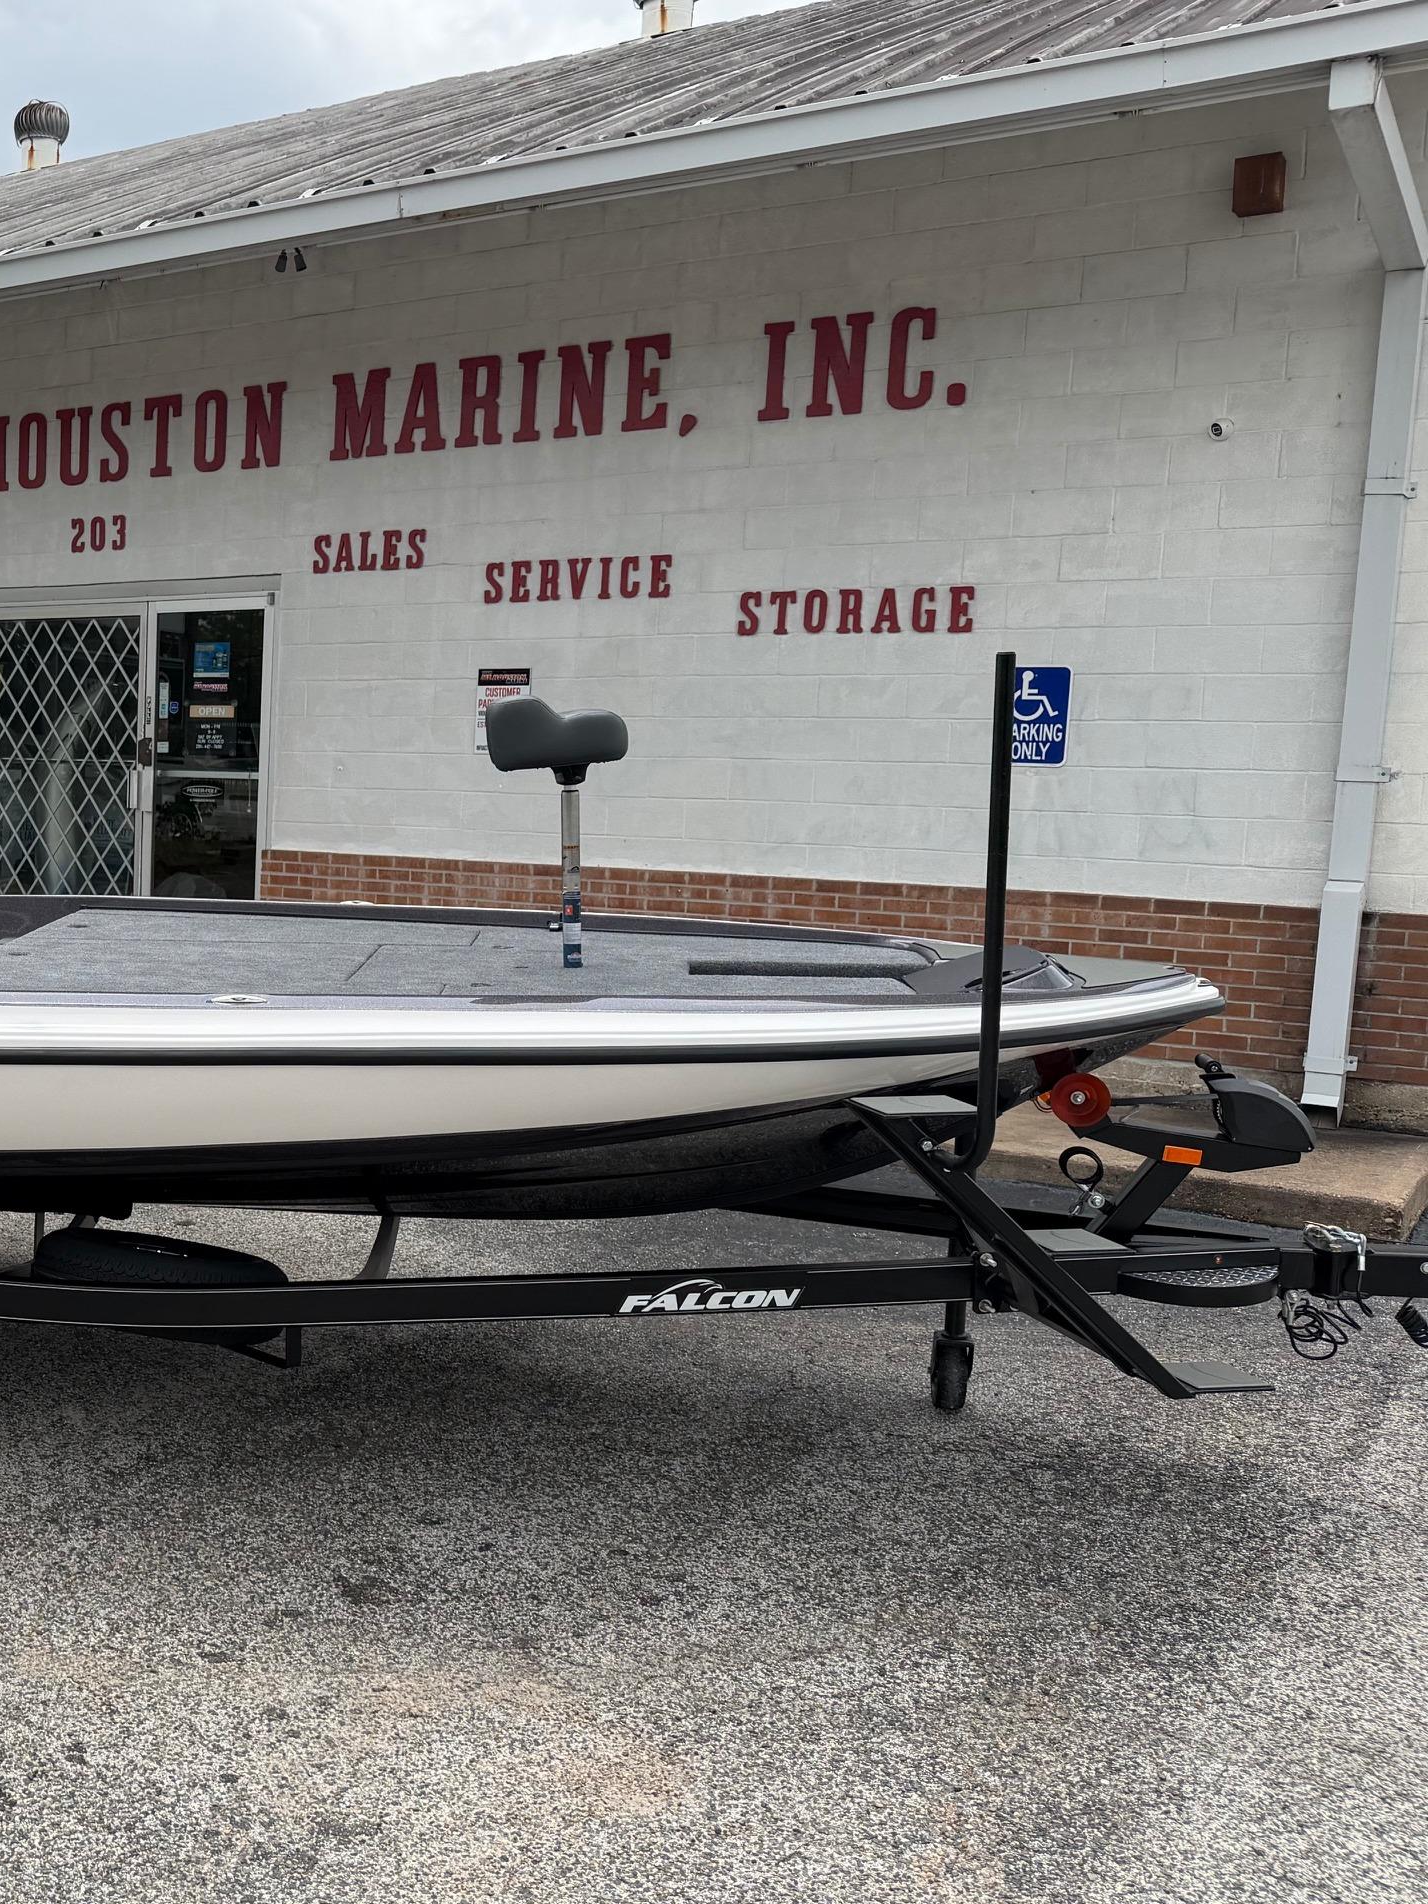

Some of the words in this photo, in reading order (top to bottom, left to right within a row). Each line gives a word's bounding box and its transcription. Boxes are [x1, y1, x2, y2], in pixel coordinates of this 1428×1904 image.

[329, 333, 697, 461] MARINE,
[757, 307, 966, 421] INC.
[71, 514, 127, 553] 203
[312, 528, 427, 574] SALES
[484, 554, 672, 604] SERVICE
[737, 585, 974, 636] STORAGE
[485, 687, 521, 698] CUSTOMER
[198, 707, 226, 716] OPEN
[1012, 723, 1063, 742] ARKING
[1012, 742, 1051, 760] ONLY
[618, 1288, 802, 1313] FALCON
